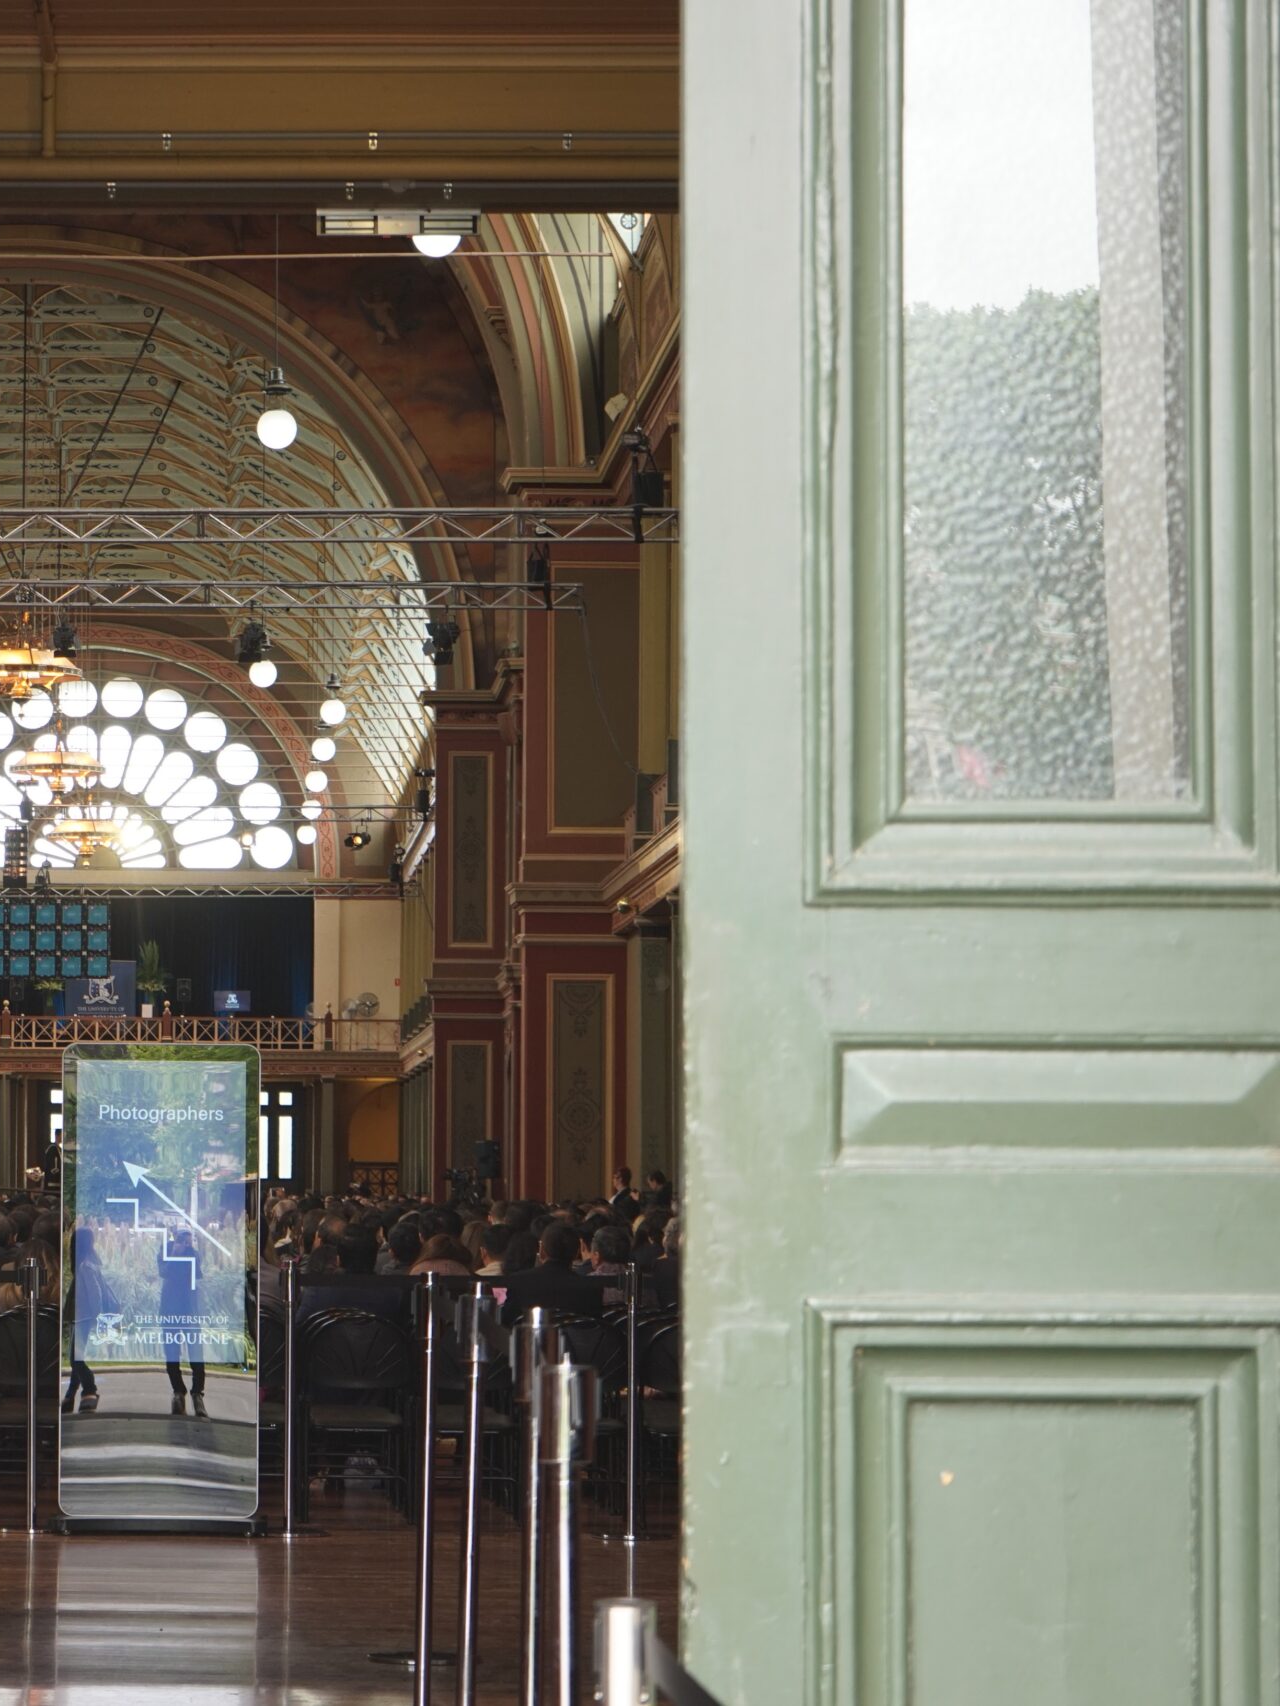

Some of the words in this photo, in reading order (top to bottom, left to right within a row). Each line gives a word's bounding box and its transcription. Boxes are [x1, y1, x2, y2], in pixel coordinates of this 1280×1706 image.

[99, 1104, 224, 1124] Photographers
[134, 1315, 153, 1324] THE
[155, 1315, 213, 1324] UNIVERSITY
[216, 1315, 229, 1324] OF
[134, 1332, 229, 1345] MELBOURNE
